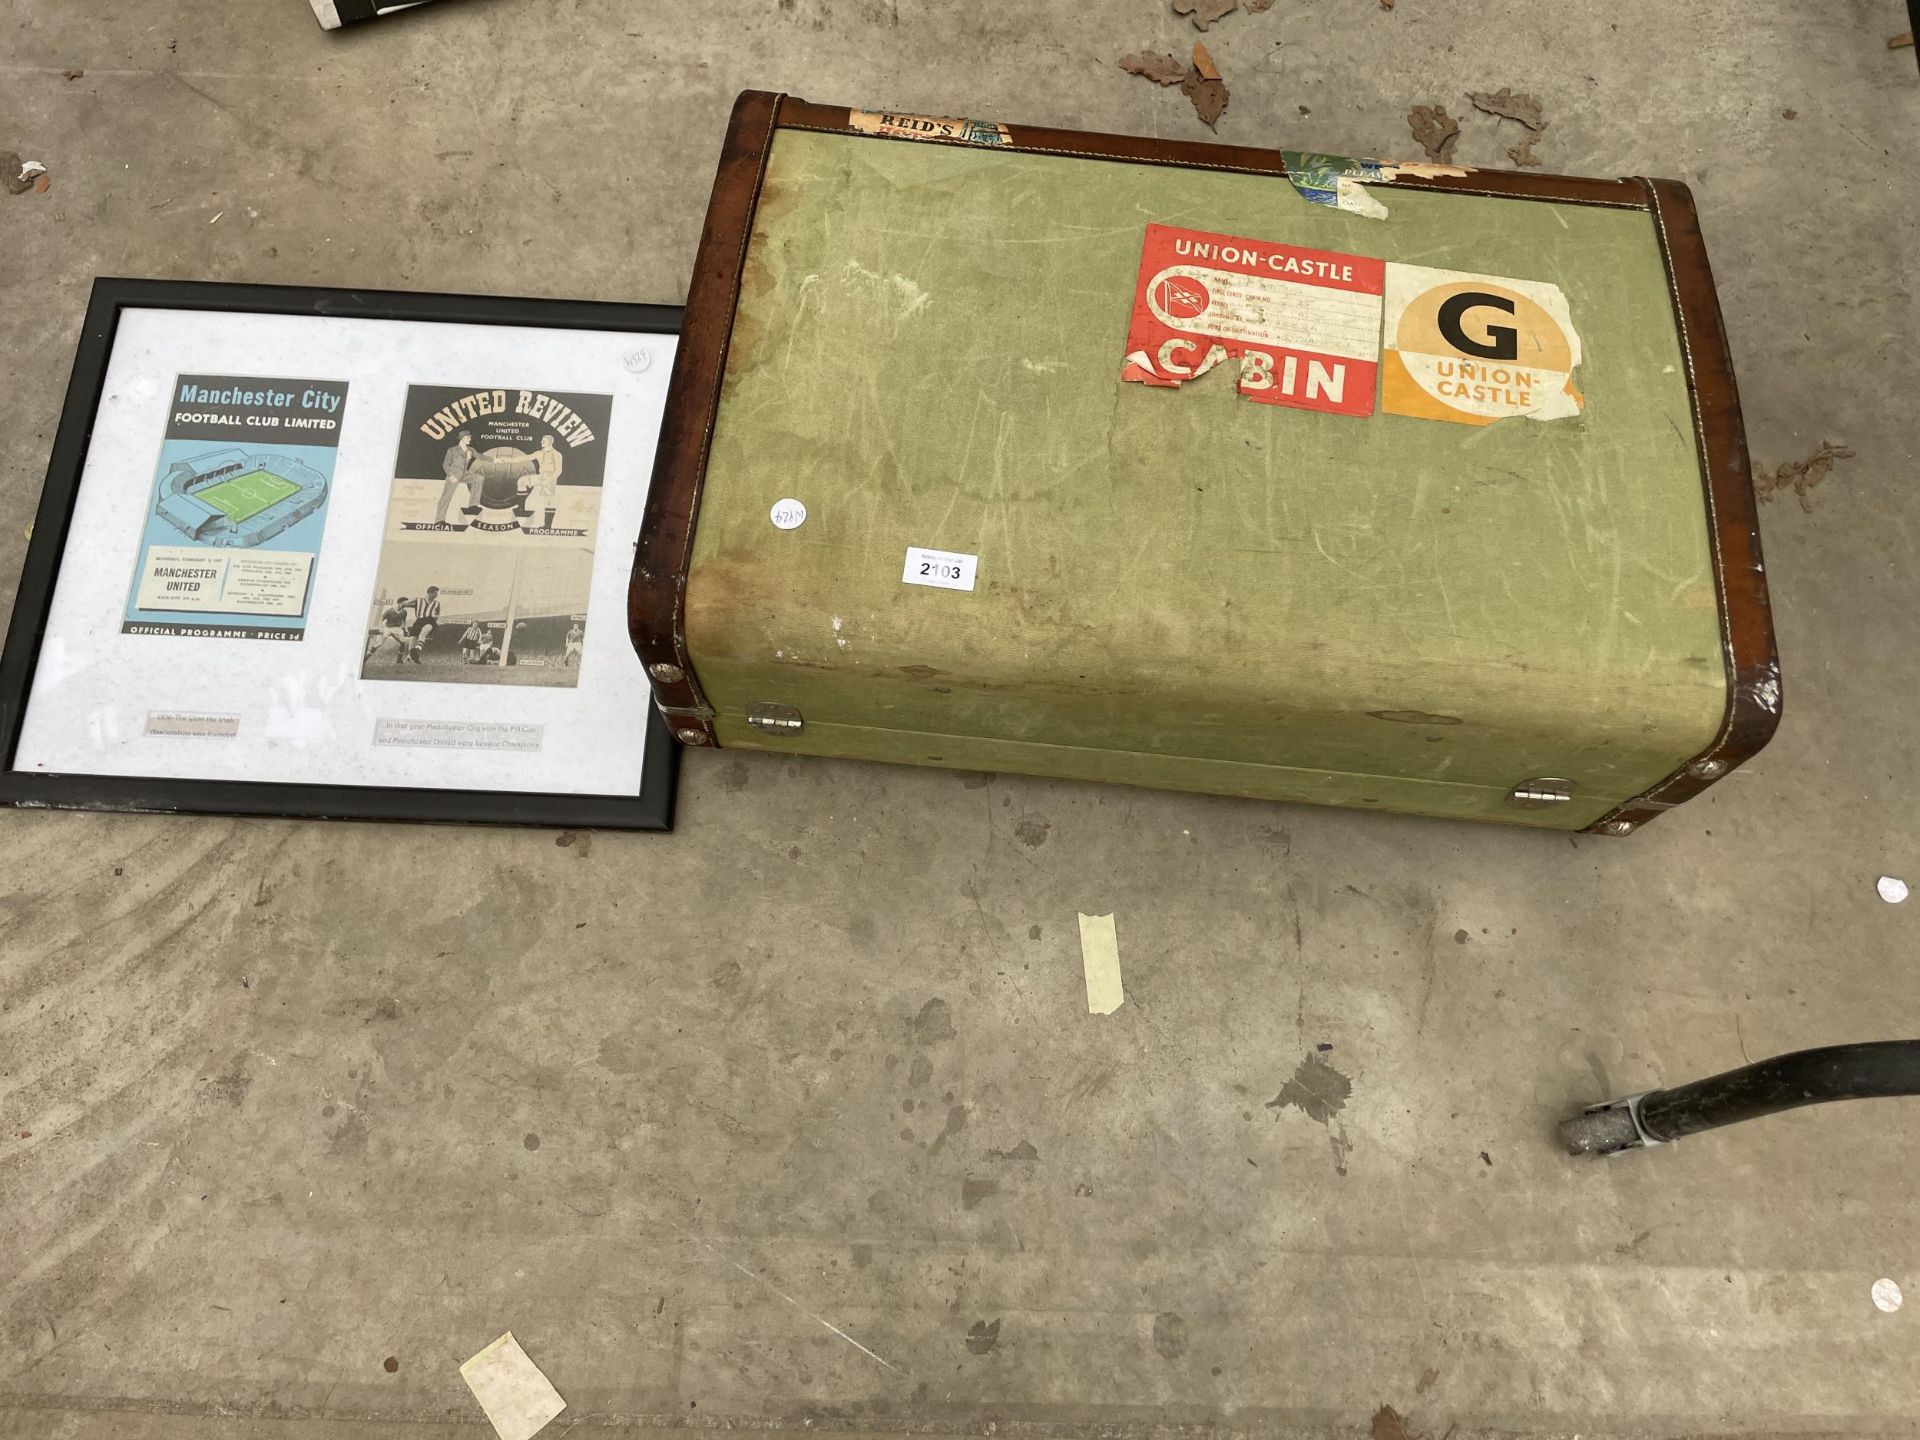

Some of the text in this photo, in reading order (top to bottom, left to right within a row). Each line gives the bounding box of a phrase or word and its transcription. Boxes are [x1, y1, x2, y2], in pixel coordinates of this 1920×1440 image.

[880, 115, 955, 136] REID'S
[1175, 239, 1353, 282] UNION-CASTLE
[1437, 292, 1518, 361] G
[1158, 338, 1346, 403] CABIN
[1437, 360, 1540, 388] UNION-
[180, 384, 341, 413] Manchester City
[1437, 380, 1531, 407] CASTLE
[175, 412, 337, 430] FOOTBALL CLUB LIMITED
[420, 390, 596, 448] UNITED REVIEW
[488, 420, 530, 428] MANCHESTER
[415, 523, 455, 532] OFFICIAL
[477, 521, 514, 532] SEASON
[529, 528, 578, 537] PROGRAMME
[154, 567, 217, 579] MANCHESTER
[919, 563, 961, 580] 2103
[166, 581, 201, 592] UNITED
[130, 626, 176, 635] OFFICIAL
[181, 628, 247, 638] PROGRAMME
[258, 631, 286, 640] PRICE
